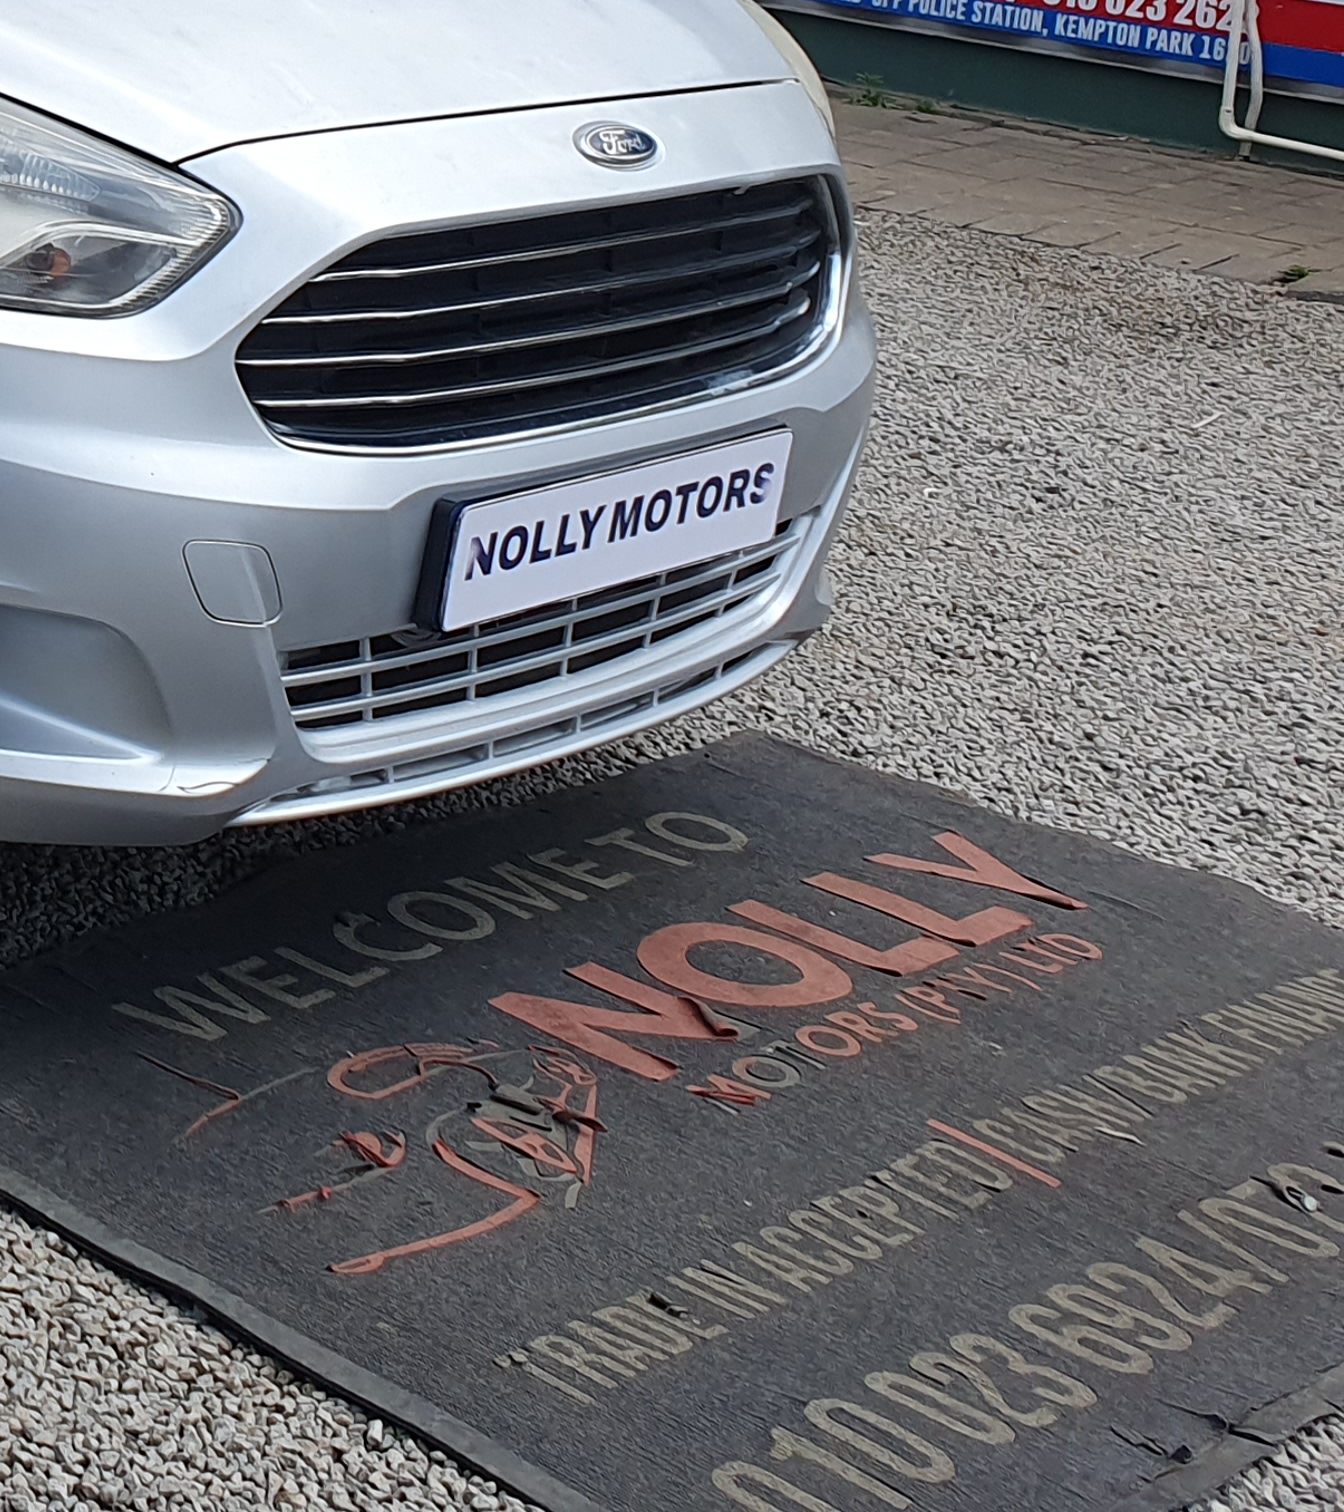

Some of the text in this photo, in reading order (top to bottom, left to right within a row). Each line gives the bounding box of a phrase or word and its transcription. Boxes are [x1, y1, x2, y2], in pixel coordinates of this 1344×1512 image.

[1054, 13, 1143, 52] KEMPTON
[1146, 27, 1195, 58] PARK
[1198, 34, 1250, 66] 160
[598, 129, 647, 156] Ford
[464, 462, 775, 582] NOLLY MOTORS
[111, 810, 749, 1042] WELCOME TO
[488, 829, 1089, 1083] NOLLY
[492, 1290, 730, 1408] TRADE
[731, 1138, 1015, 1293] ACCEPTED
[863, 1332, 1098, 1447] 023
